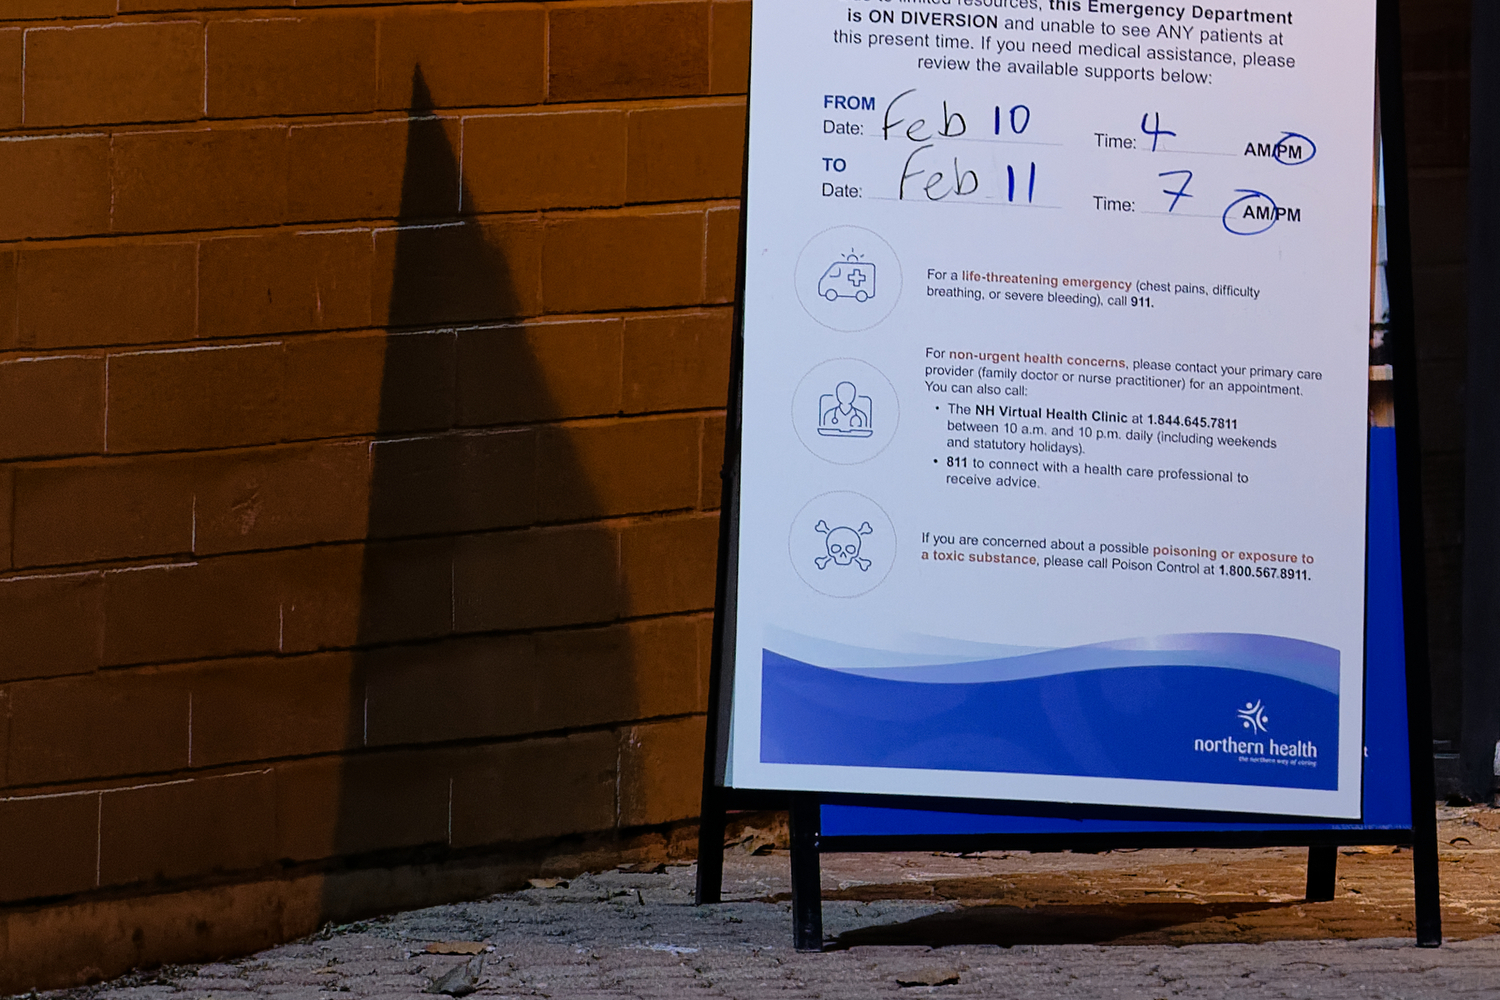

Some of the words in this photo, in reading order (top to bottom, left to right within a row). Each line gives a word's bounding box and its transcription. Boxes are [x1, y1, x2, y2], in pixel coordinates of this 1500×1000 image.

[1088, 0, 1185, 21] Emergency
[1192, 5, 1292, 25] Department
[848, 8, 862, 23] is
[869, 9, 894, 24] ON
[901, 11, 998, 29] DIVERSION
[1004, 17, 1034, 31] and
[1041, 19, 1095, 34] unable
[1101, 22, 1116, 35] to
[1122, 25, 1150, 38] see
[1156, 24, 1194, 40] ANY
[1200, 28, 1262, 44] patients
[1269, 32, 1283, 46] at
[834, 29, 862, 44] this
[868, 34, 929, 48] present
[935, 34, 974, 49] time.
[981, 36, 991, 50] If
[996, 40, 1025, 55] you
[1032, 40, 1072, 55] need
[1078, 43, 1140, 58] medical
[1146, 46, 1236, 66] assistance,
[1243, 51, 1295, 68] please
[824, 95, 875, 111] FROM
[882, 88, 967, 142] Feb
[994, 104, 1030, 135] 10
[823, 120, 863, 135] Date:
[1141, 112, 1177, 152] 4
[1094, 133, 1136, 149] Time:
[1244, 142, 1302, 159] AM/PM
[822, 157, 846, 172] TO
[900, 144, 979, 201] Feb
[1007, 161, 1036, 203] 11
[822, 182, 862, 198] Date:
[1159, 170, 1194, 212] 7
[1093, 196, 1135, 212] Time:
[1242, 205, 1301, 222] AM/PM
[927, 268, 947, 280] For
[950, 272, 958, 281] a
[962, 270, 1058, 289] life-threatening
[1062, 278, 1132, 293] emergency
[1136, 280, 1171, 293] (chest
[1174, 283, 1208, 296] pains,
[1212, 284, 1260, 300] difficulty
[927, 285, 985, 301] breathing,
[989, 291, 1001, 299] or
[1005, 291, 1044, 302] severe
[1047, 291, 1103, 307] bleeding),
[1107, 295, 1127, 306] call
[1131, 296, 1154, 308] 911.
[948, 403, 971, 415] The
[975, 404, 995, 416] NH
[999, 405, 1042, 418] Virtual
[1046, 408, 1087, 421] Health
[1092, 410, 1128, 423] Clinic
[1132, 414, 1143, 424] at
[1148, 414, 1237, 429] 1.844.645.7811
[922, 532, 930, 543] If
[933, 535, 955, 547] you
[959, 536, 979, 546] are
[982, 537, 1046, 549] concerned
[1050, 539, 1085, 551] about
[1088, 543, 1096, 551] a
[1100, 542, 1149, 555] possible
[1153, 545, 1217, 561] poisoning
[1221, 550, 1235, 559] or
[1238, 551, 1298, 564] exposure
[1302, 554, 1314, 564] to
[921, 551, 929, 560] a
[933, 550, 964, 561] toxic
[969, 552, 1039, 566] substance,
[1044, 555, 1083, 568] please
[1087, 557, 1108, 568] call
[1112, 558, 1152, 571] Poison
[1157, 560, 1199, 574] Control
[1203, 564, 1215, 575] at
[1219, 564, 1311, 581] 1.800.567.8911.
[1195, 736, 1264, 755] northern
[1270, 739, 1317, 758] health
